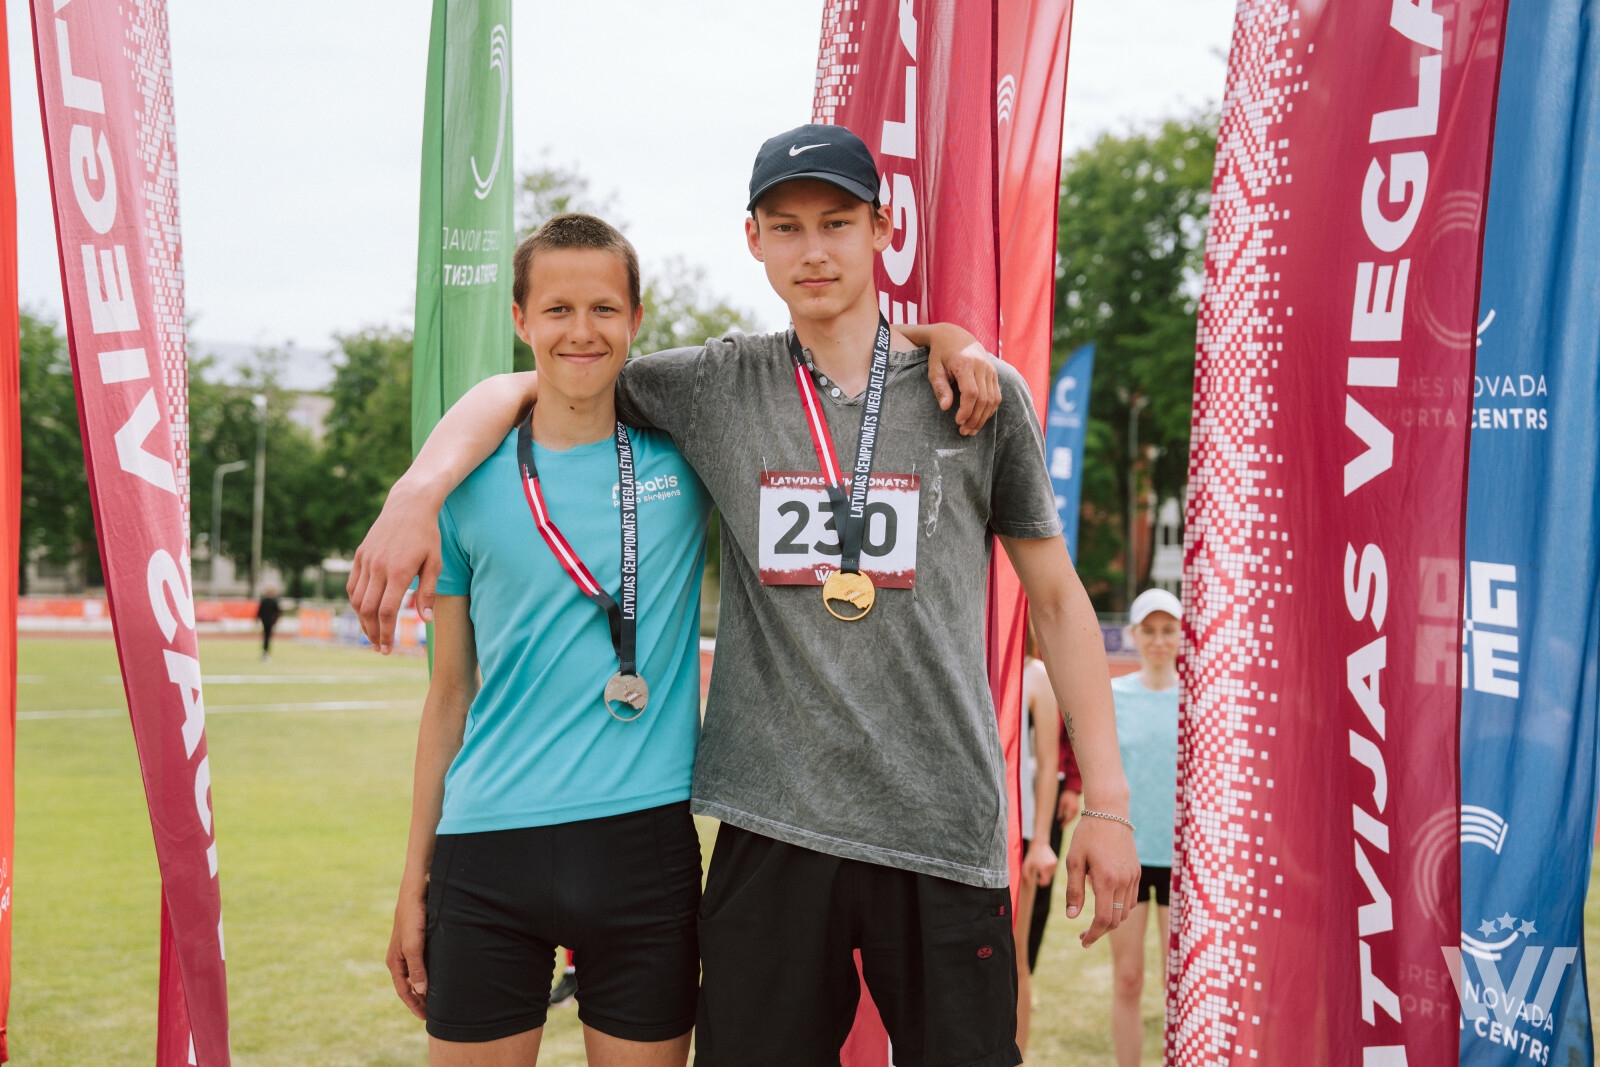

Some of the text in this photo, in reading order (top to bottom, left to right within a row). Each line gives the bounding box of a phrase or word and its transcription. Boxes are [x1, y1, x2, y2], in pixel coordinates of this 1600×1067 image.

[617, 421, 628, 444] 2023
[850, 326, 890, 518] LATVIJAS ČEMPIONĀTS VIEGLATLĒTIKĀ 2023
[617, 444, 636, 511] VIEGLATLĒTIKĀ
[770, 476, 826, 487] LATVIJAS
[621, 512, 637, 574] ČEMPIONĀTS
[774, 500, 898, 557] 230
[623, 575, 635, 620] LATVIJAS
[1344, 541, 1410, 1067] TVIJAS
[1465, 979, 1554, 1035] NOVADA
[1475, 1015, 1550, 1066] CENTRS
